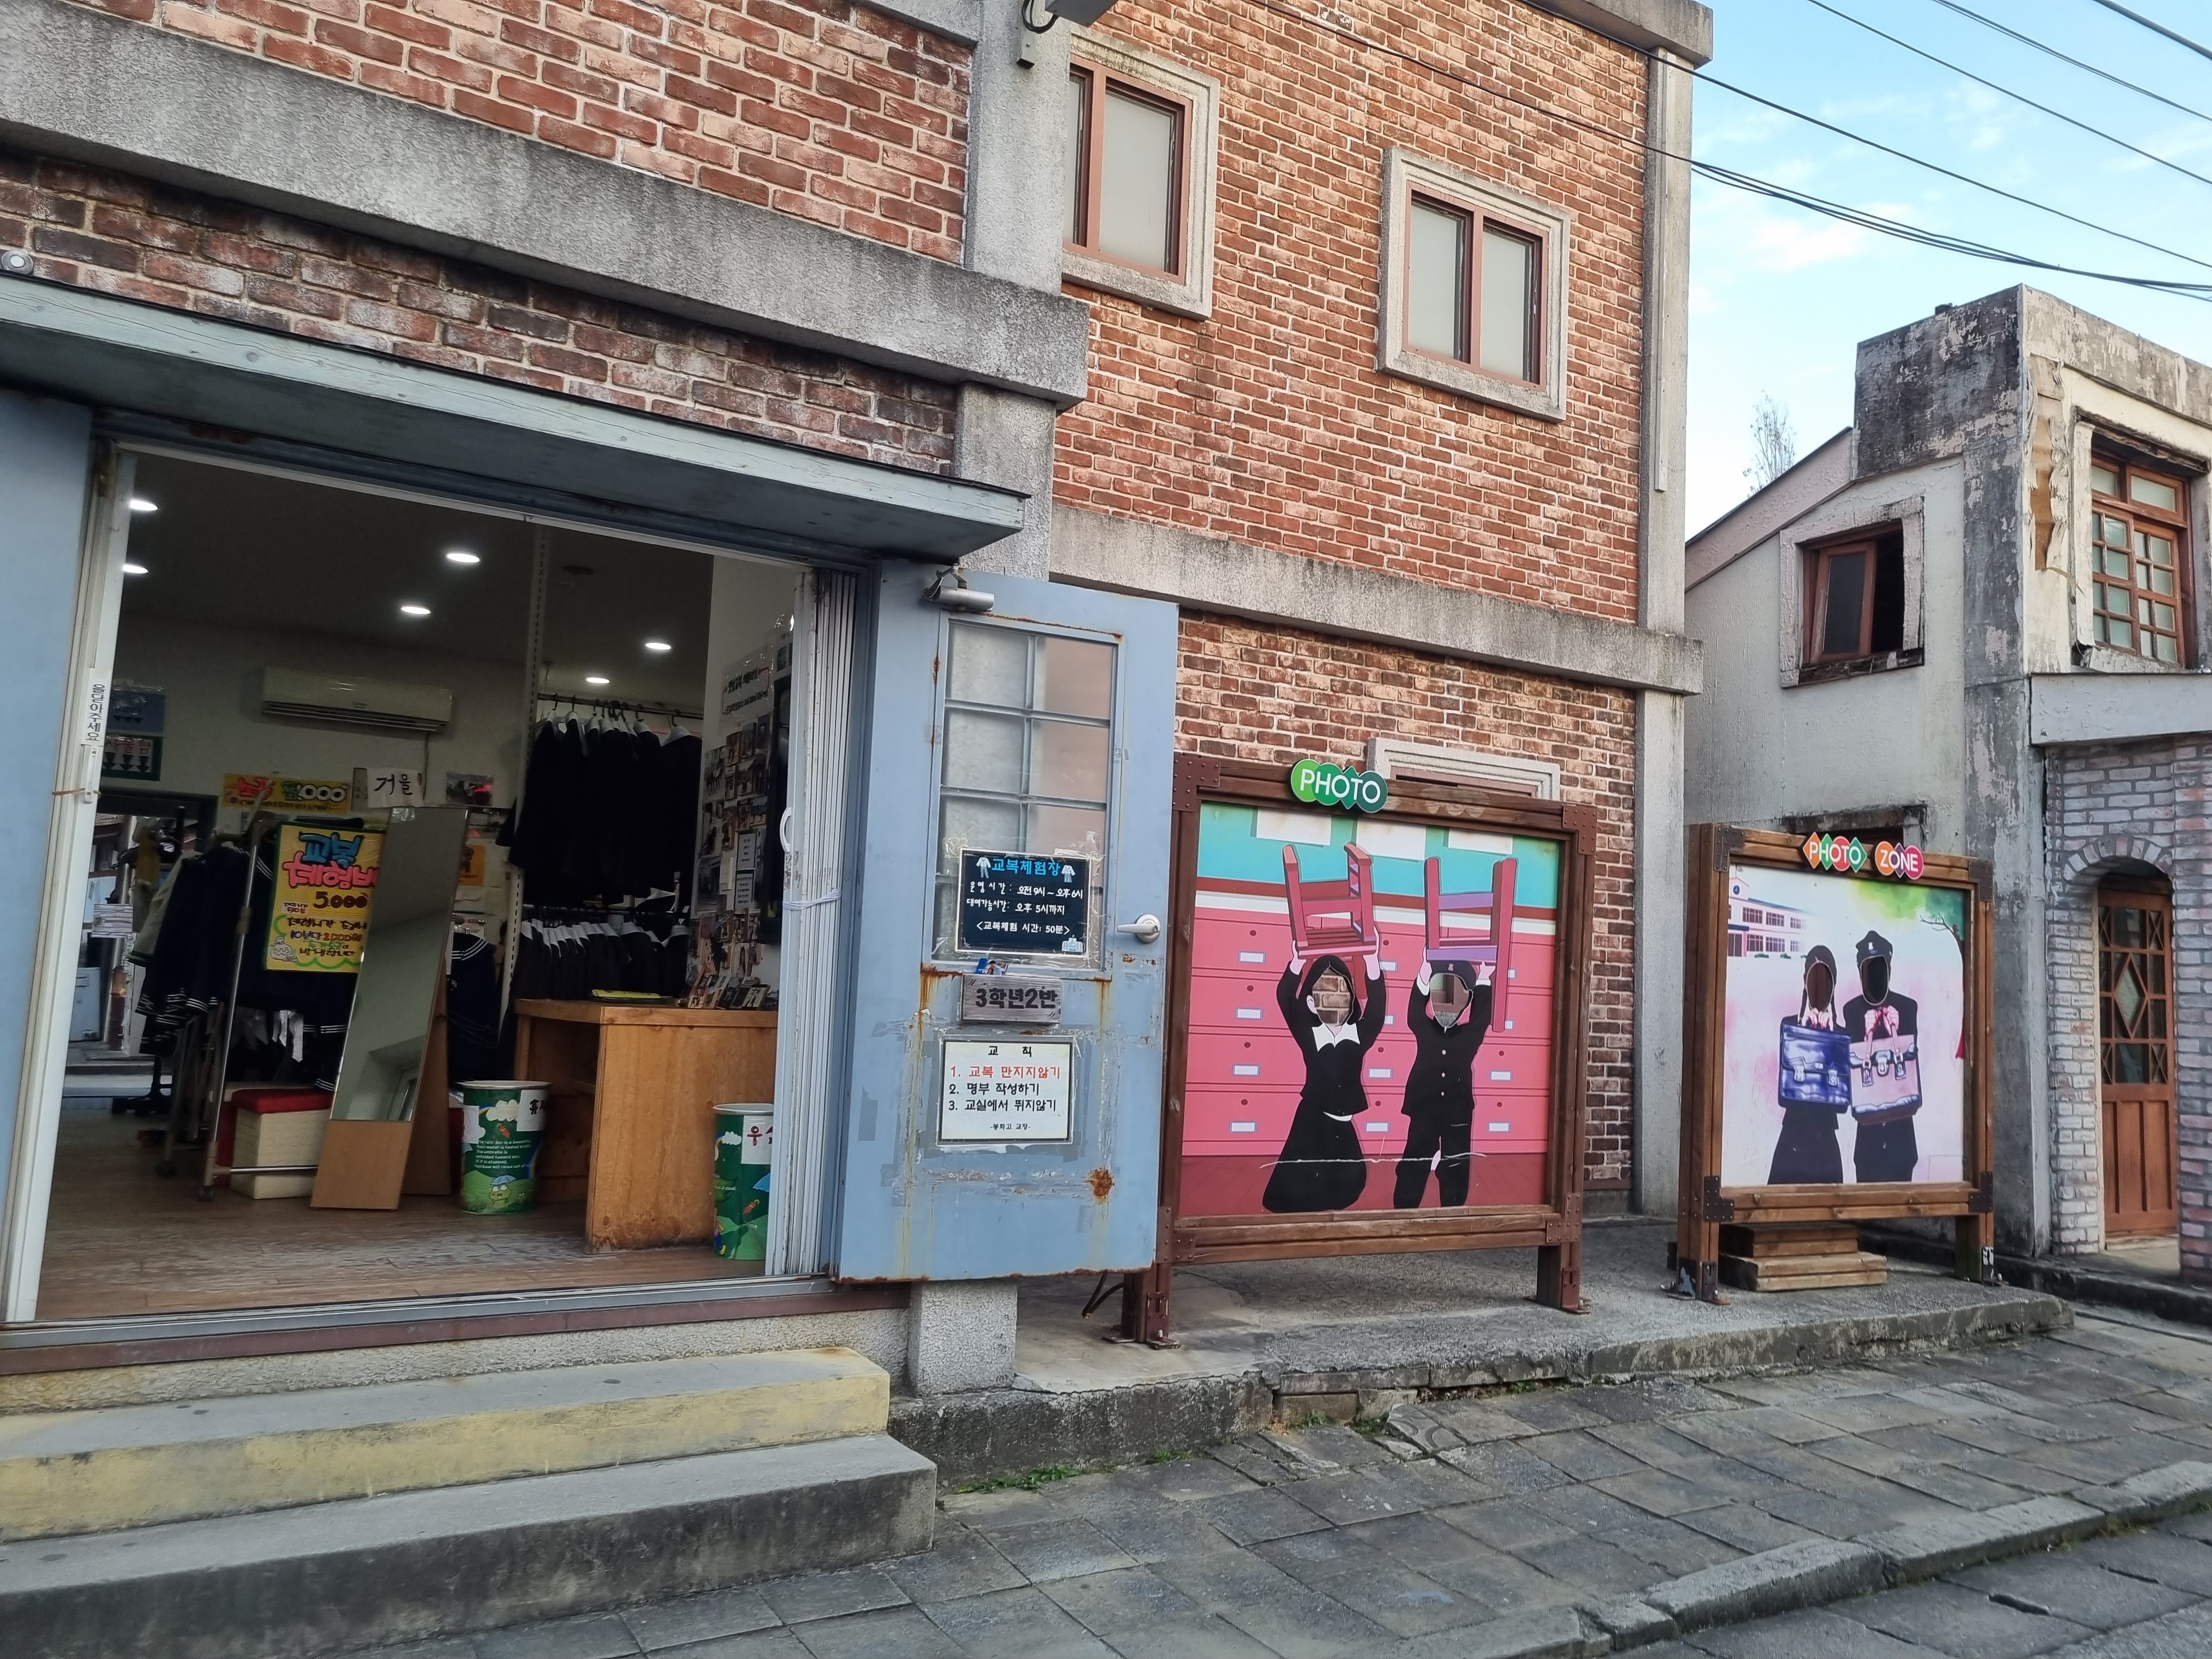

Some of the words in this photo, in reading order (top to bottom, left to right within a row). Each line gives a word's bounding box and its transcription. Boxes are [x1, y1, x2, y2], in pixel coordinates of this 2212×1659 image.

[1300, 769, 1380, 803] PHOTO
[299, 832, 364, 868] 교복
[1809, 841, 1861, 865] PHOTO
[1880, 849, 1918, 872] ZONE
[992, 858, 1060, 876] 교복체험장
[1015, 903, 1032, 913] 오후
[1036, 905, 1065, 916] 5시까지
[975, 988, 1057, 1009] 3학년2반
[950, 1066, 961, 1077] 1.
[969, 1066, 994, 1079] 교복
[1001, 1066, 1060, 1079] 만지지않기
[949, 1084, 959, 1094] 2.
[967, 1082, 989, 1096] 명부
[996, 1083, 1039, 1096] 작성하기
[948, 1100, 958, 1110] 3.
[964, 1099, 1008, 1111] 교실에서
[1014, 1100, 1056, 1111] 뛰지않기
